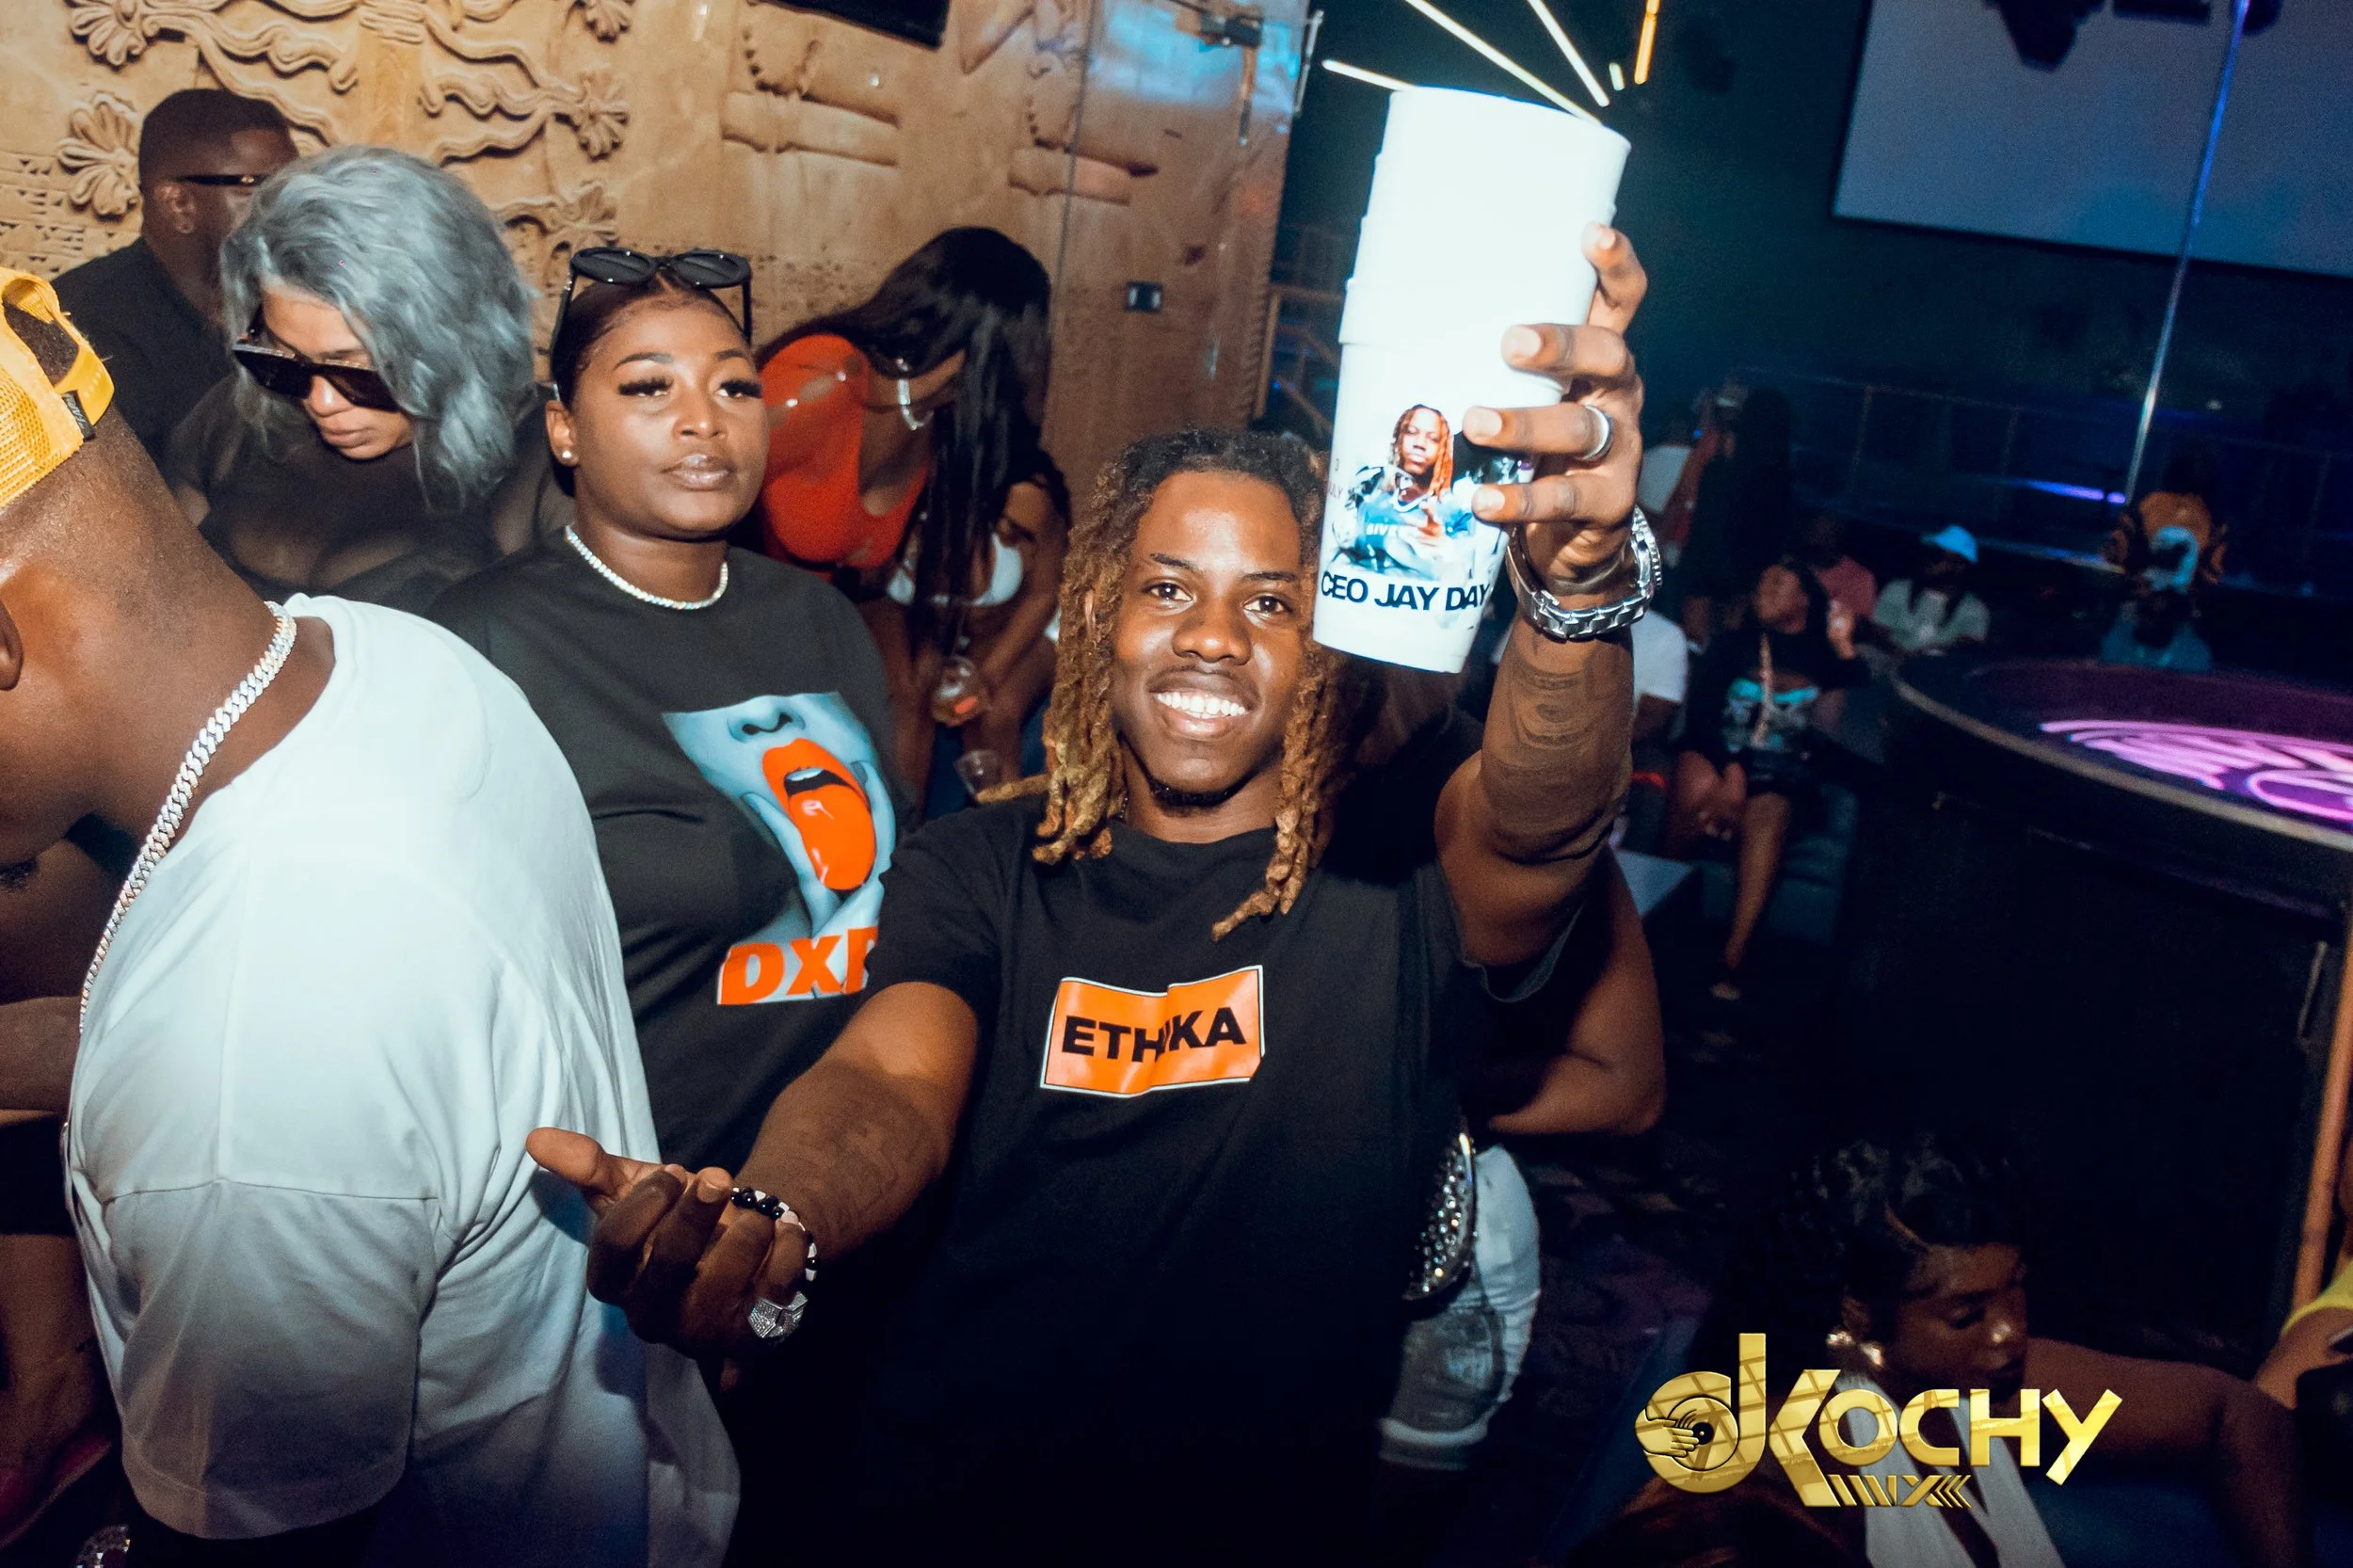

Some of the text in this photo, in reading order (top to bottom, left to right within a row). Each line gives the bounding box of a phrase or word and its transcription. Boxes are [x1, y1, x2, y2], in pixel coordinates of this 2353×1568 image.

[1321, 570, 1490, 611] CEO JAY DAY
